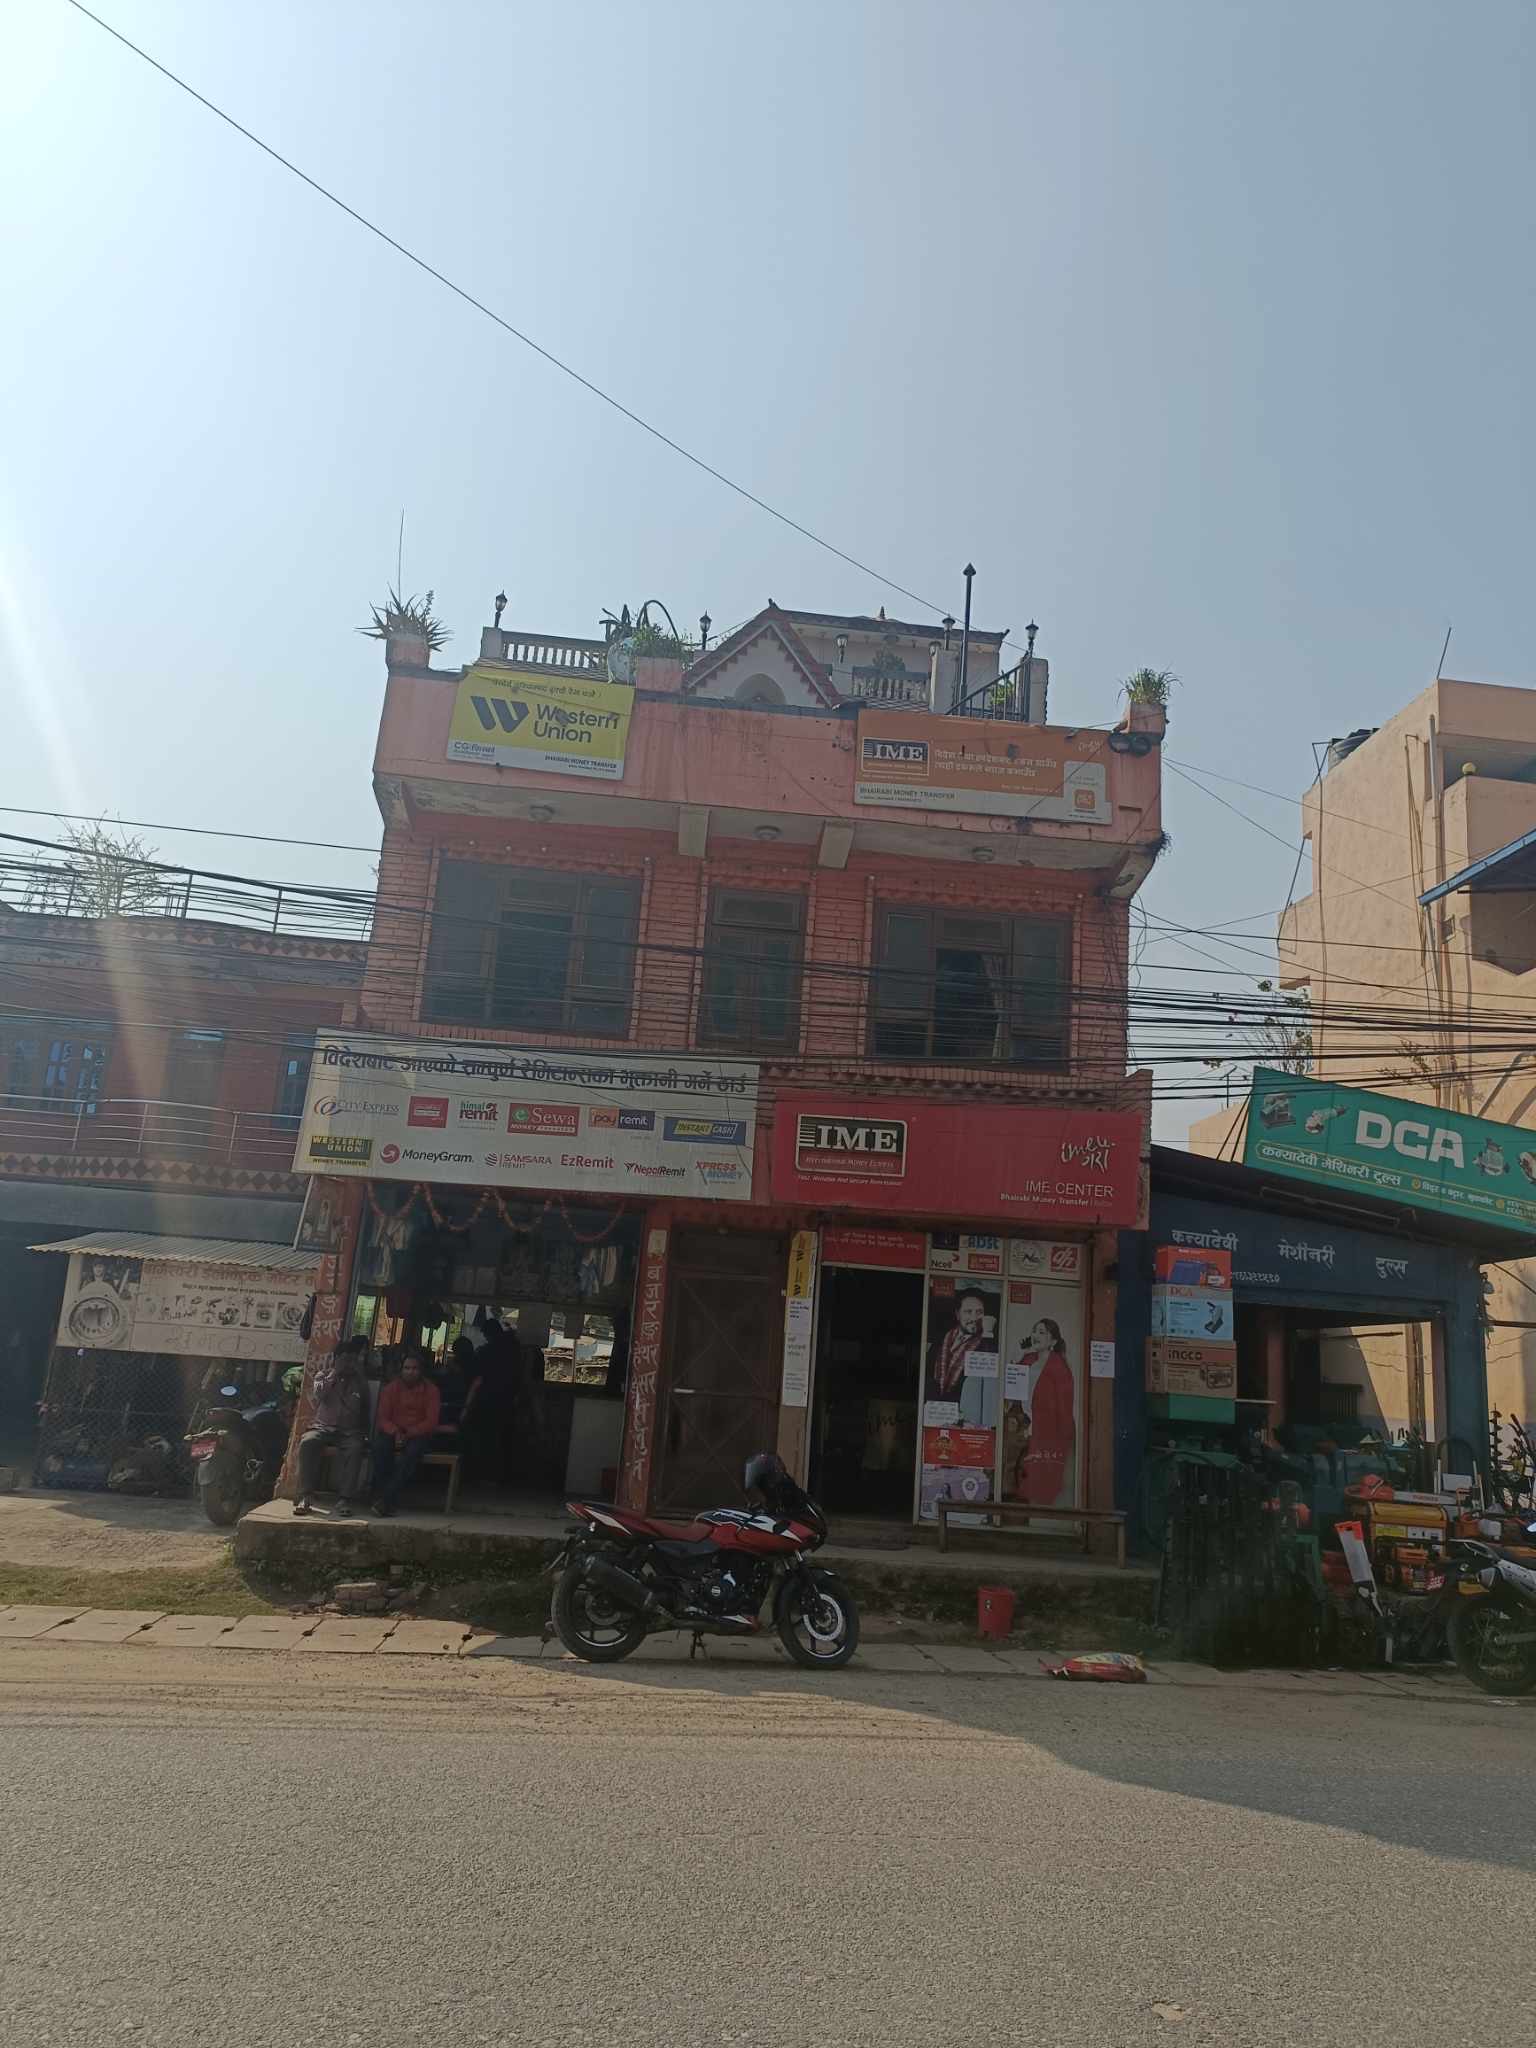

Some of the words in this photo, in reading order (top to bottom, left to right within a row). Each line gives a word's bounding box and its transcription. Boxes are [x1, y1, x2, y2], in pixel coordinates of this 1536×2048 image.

[534, 721, 592, 743] Union
[873, 744, 924, 761] IME
[459, 1108, 499, 1121] remit
[620, 1112, 648, 1125] remit
[815, 1125, 898, 1152] IME
[1355, 1110, 1465, 1168] DCA
[327, 1144, 362, 1153] UNION
[560, 1154, 615, 1169] EzRemit
[1025, 1180, 1050, 1193] IME
[1055, 1182, 1114, 1197] CENTER
